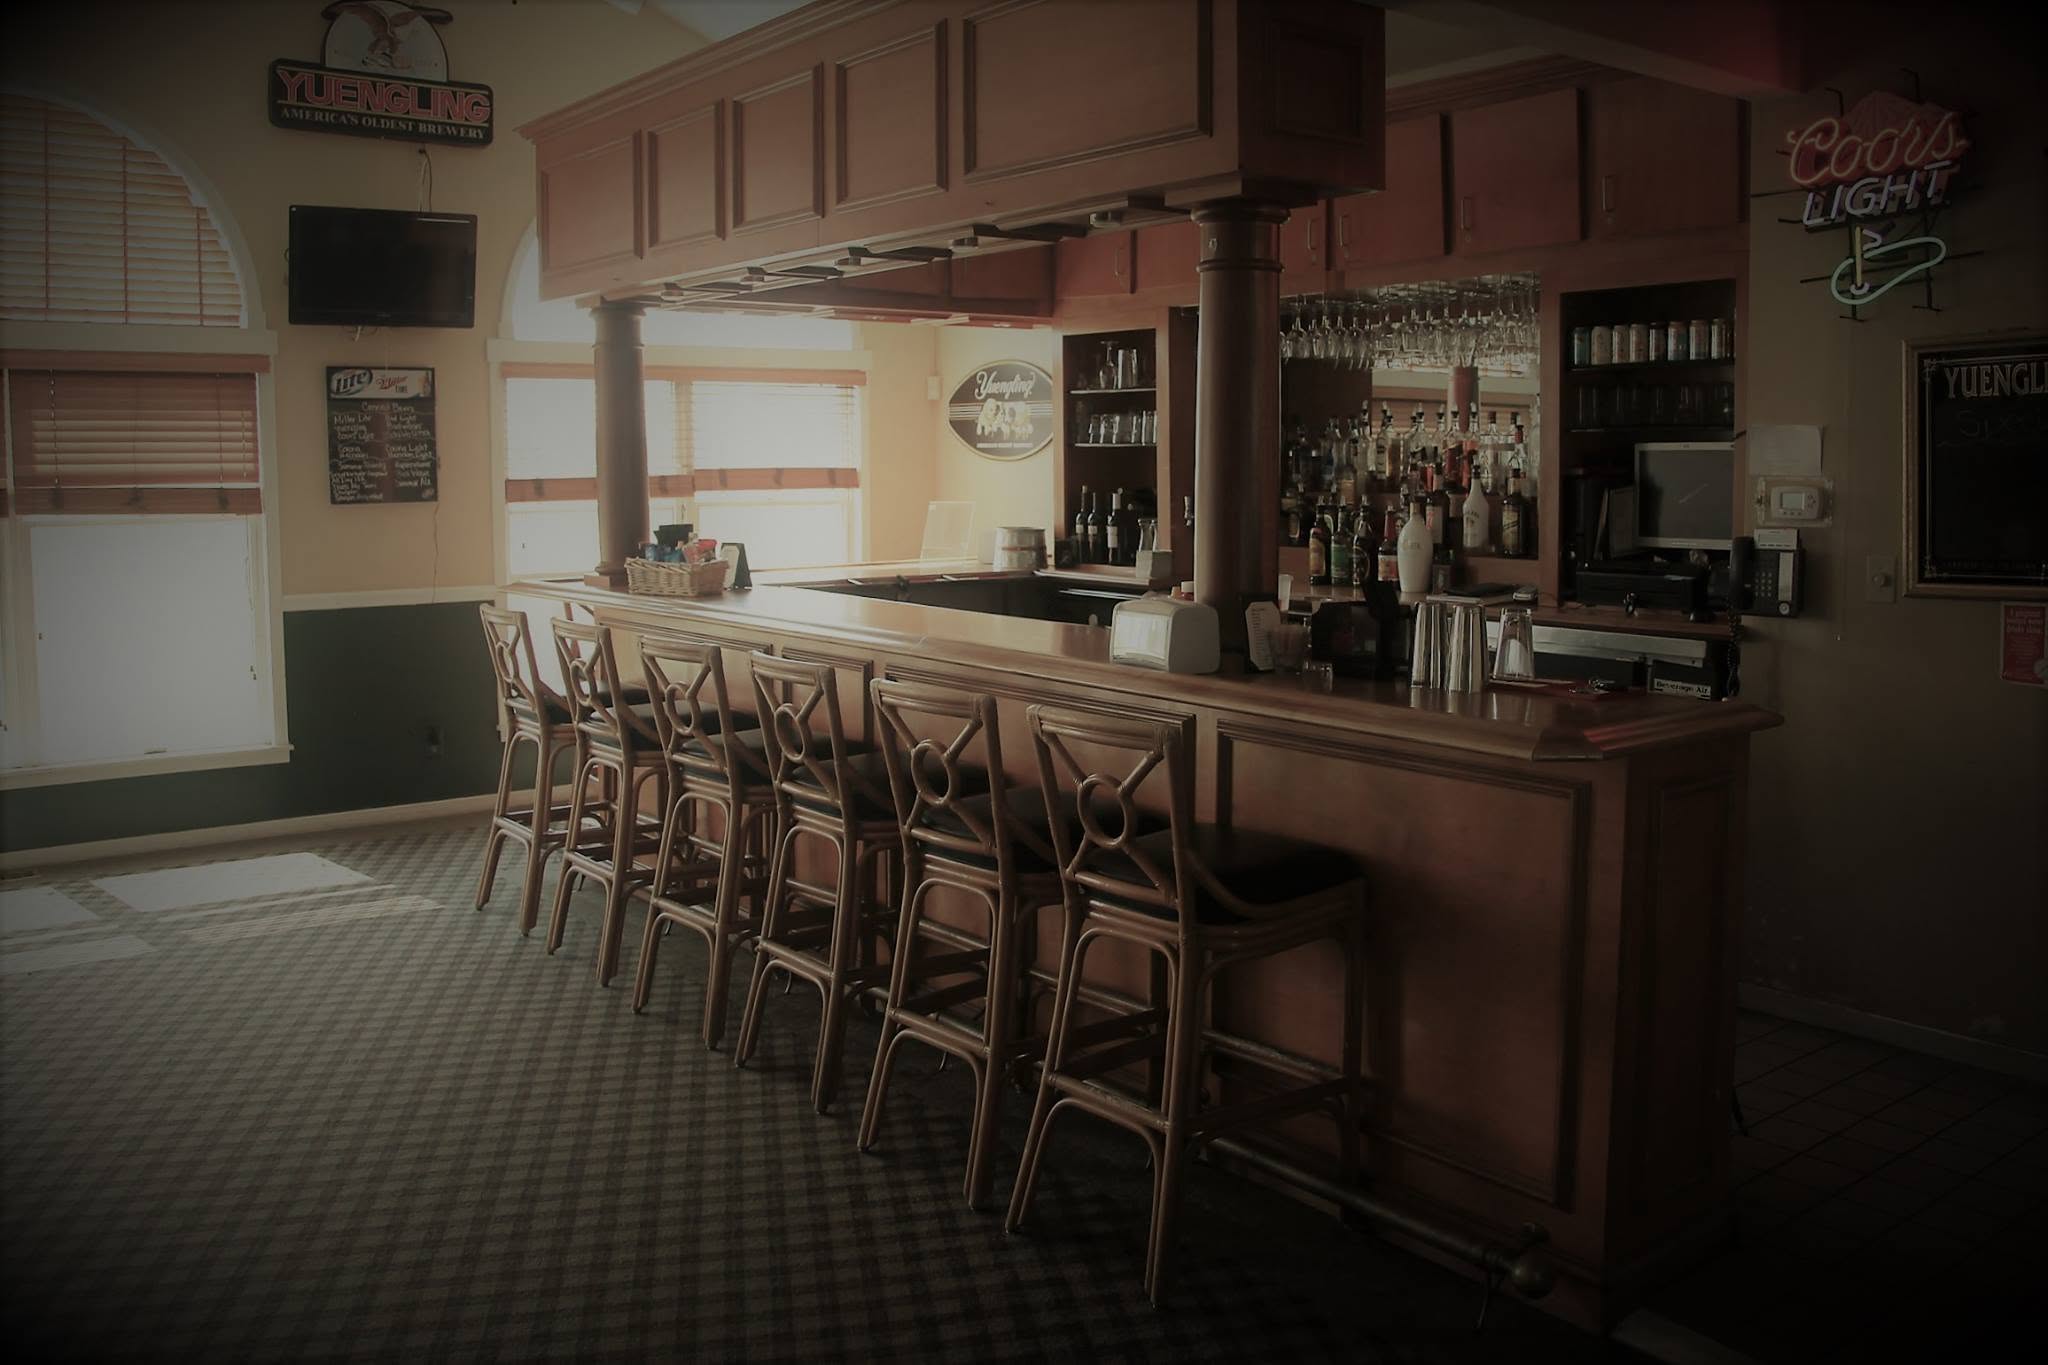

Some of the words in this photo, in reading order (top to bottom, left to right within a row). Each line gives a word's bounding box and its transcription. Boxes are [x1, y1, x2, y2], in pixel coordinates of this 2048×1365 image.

[275, 69, 490, 124] YUENGLING
[280, 109, 359, 126] AMERICA'S
[362, 116, 415, 132] OLDEST
[417, 122, 485, 139] BREWERY
[1787, 111, 1972, 186] Coors
[1802, 160, 1954, 225] LIGHT
[974, 370, 1037, 400] Yuengling
